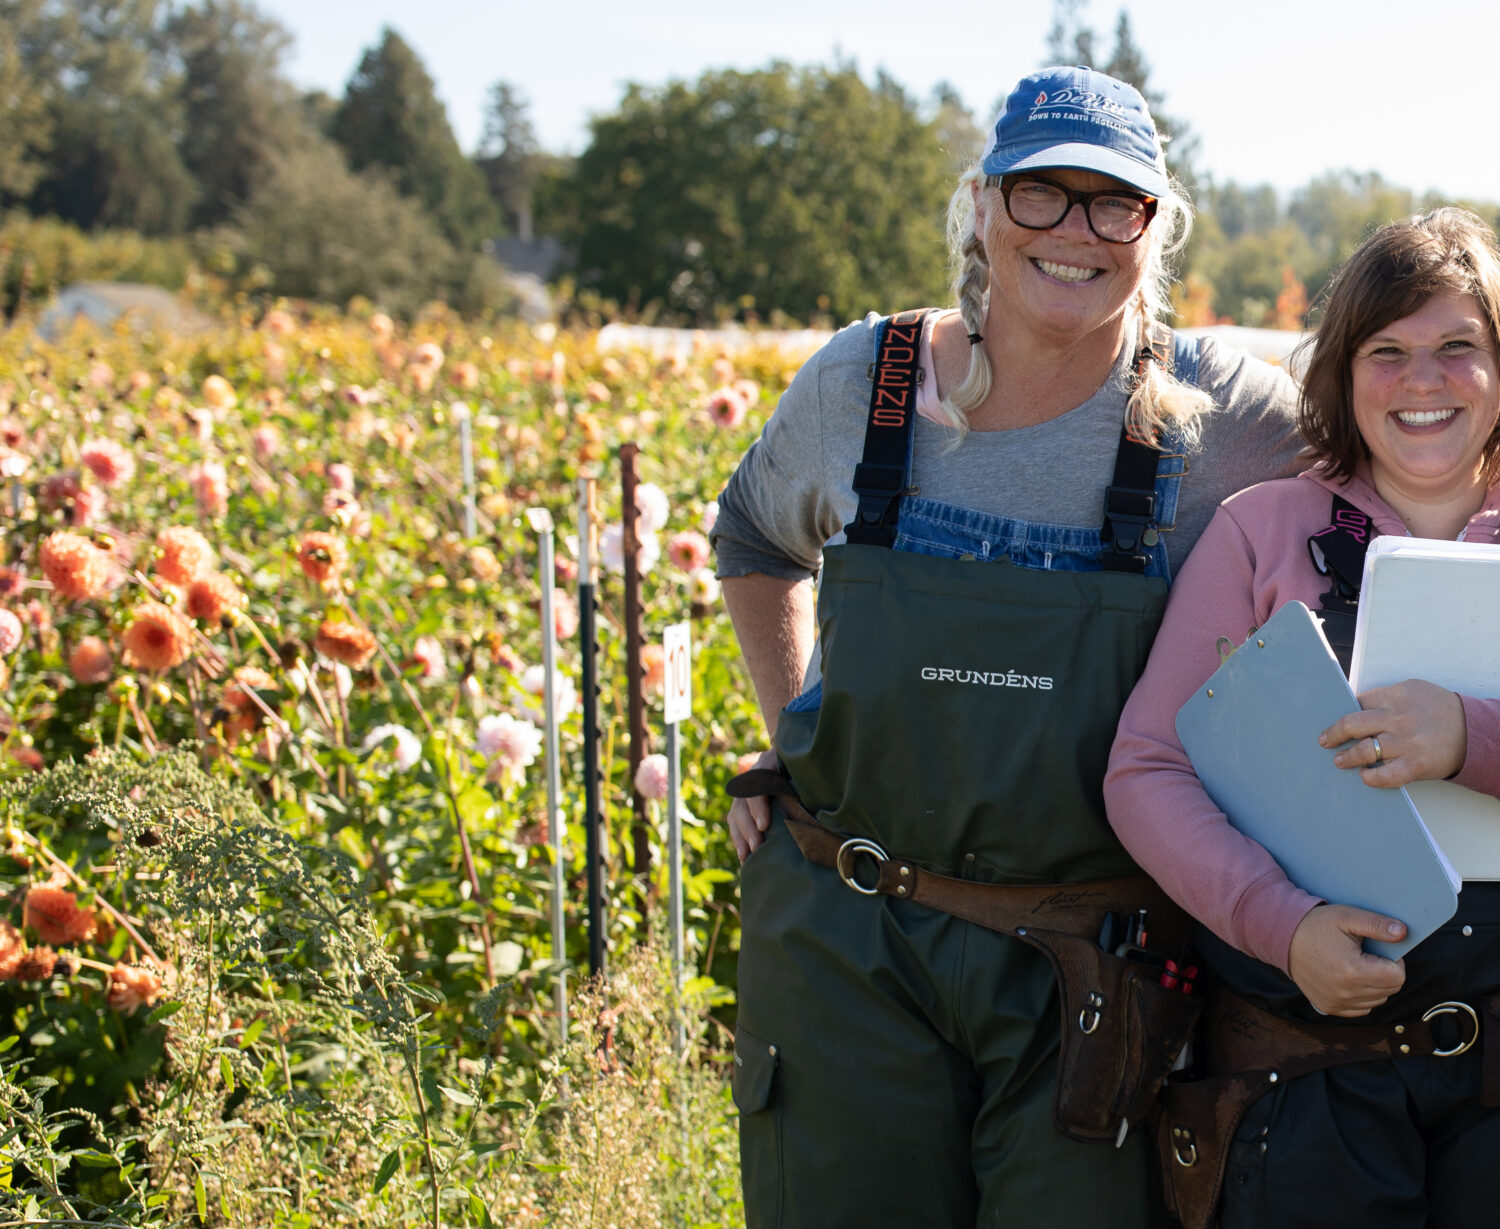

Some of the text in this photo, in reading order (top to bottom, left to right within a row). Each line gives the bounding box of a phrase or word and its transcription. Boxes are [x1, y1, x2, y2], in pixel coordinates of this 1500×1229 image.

[1028, 112, 1048, 121] DOWN
[1063, 112, 1088, 122] EARTH
[1091, 117, 1132, 135] PROTECTION
[921, 667, 1054, 690] GRUNDÉNS
